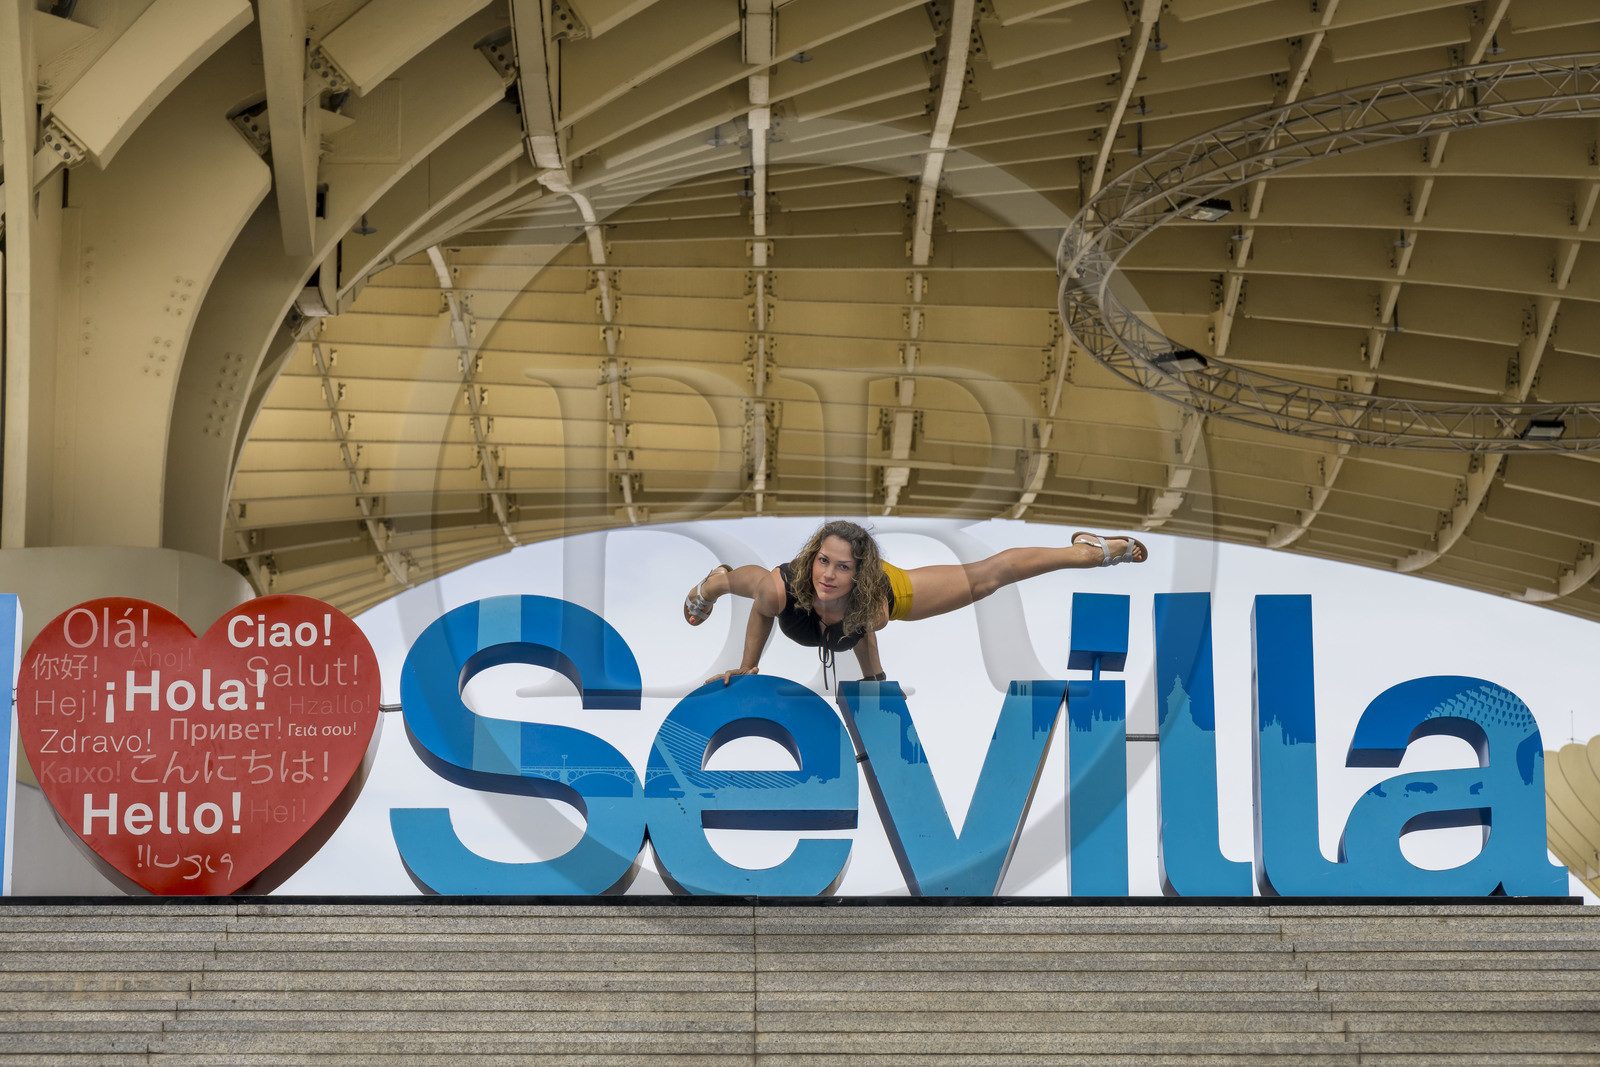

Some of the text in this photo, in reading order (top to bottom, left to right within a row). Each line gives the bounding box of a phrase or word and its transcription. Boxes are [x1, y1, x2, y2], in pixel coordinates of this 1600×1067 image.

[63, 607, 149, 649] Olá!
[227, 613, 332, 648] Ciao!
[131, 647, 192, 673] Ahoj!
[245, 654, 358, 687] Salut!
[35, 689, 97, 723] Hej!
[105, 668, 266, 723] ¡Hola!
[289, 694, 371, 715] Hzallo!
[40, 728, 151, 753] Zdravo!
[169, 716, 282, 747] Привет!
[321, 721, 357, 736] σου!
[389, 592, 1570, 897] Sevilla
[83, 791, 242, 836] Hello!
[250, 798, 307, 823] Hei!
